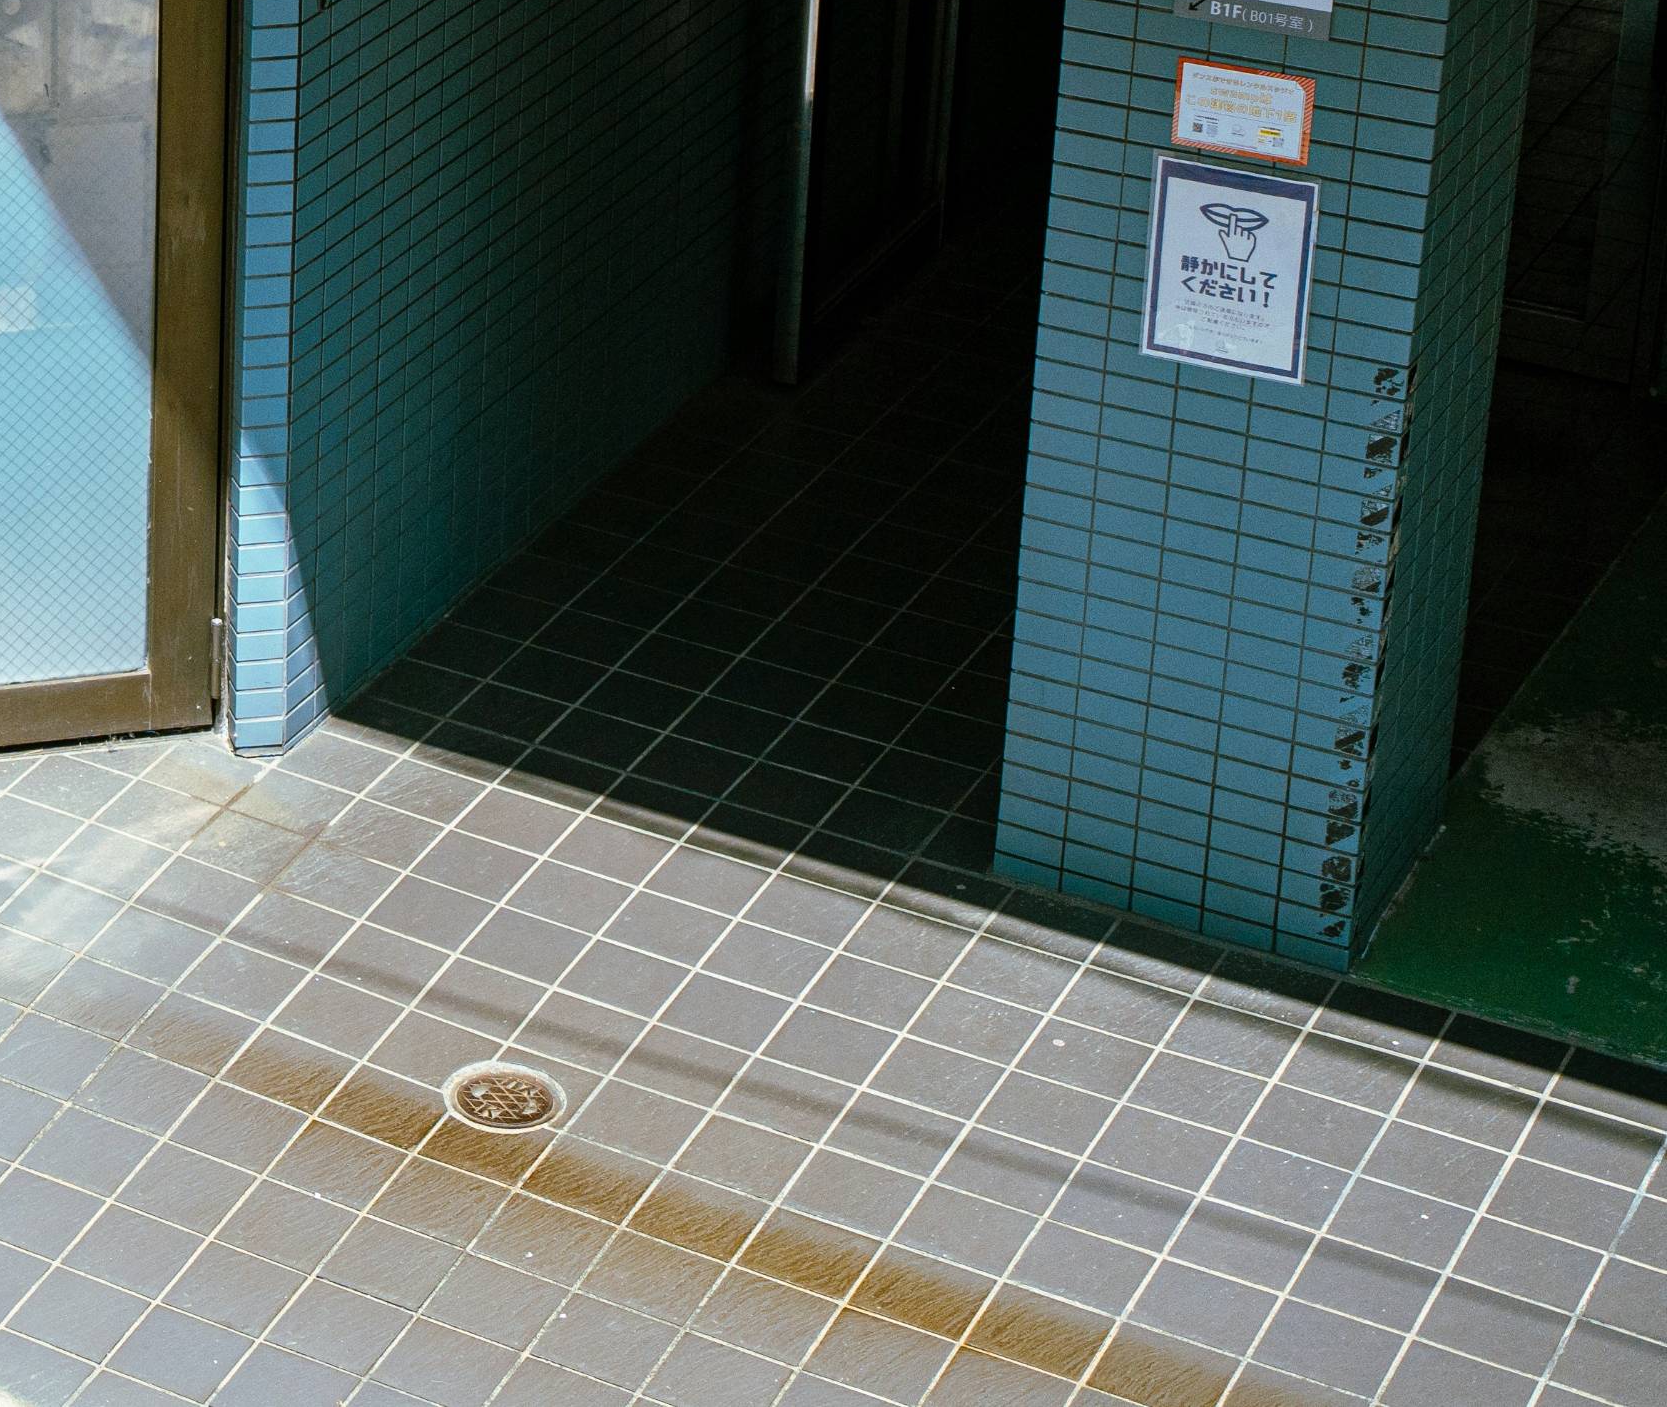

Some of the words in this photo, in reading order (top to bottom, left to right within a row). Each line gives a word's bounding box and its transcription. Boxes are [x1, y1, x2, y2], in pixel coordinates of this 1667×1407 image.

[1180, 255, 1278, 289] 静かにして
[1180, 276, 1270, 308] ください!
